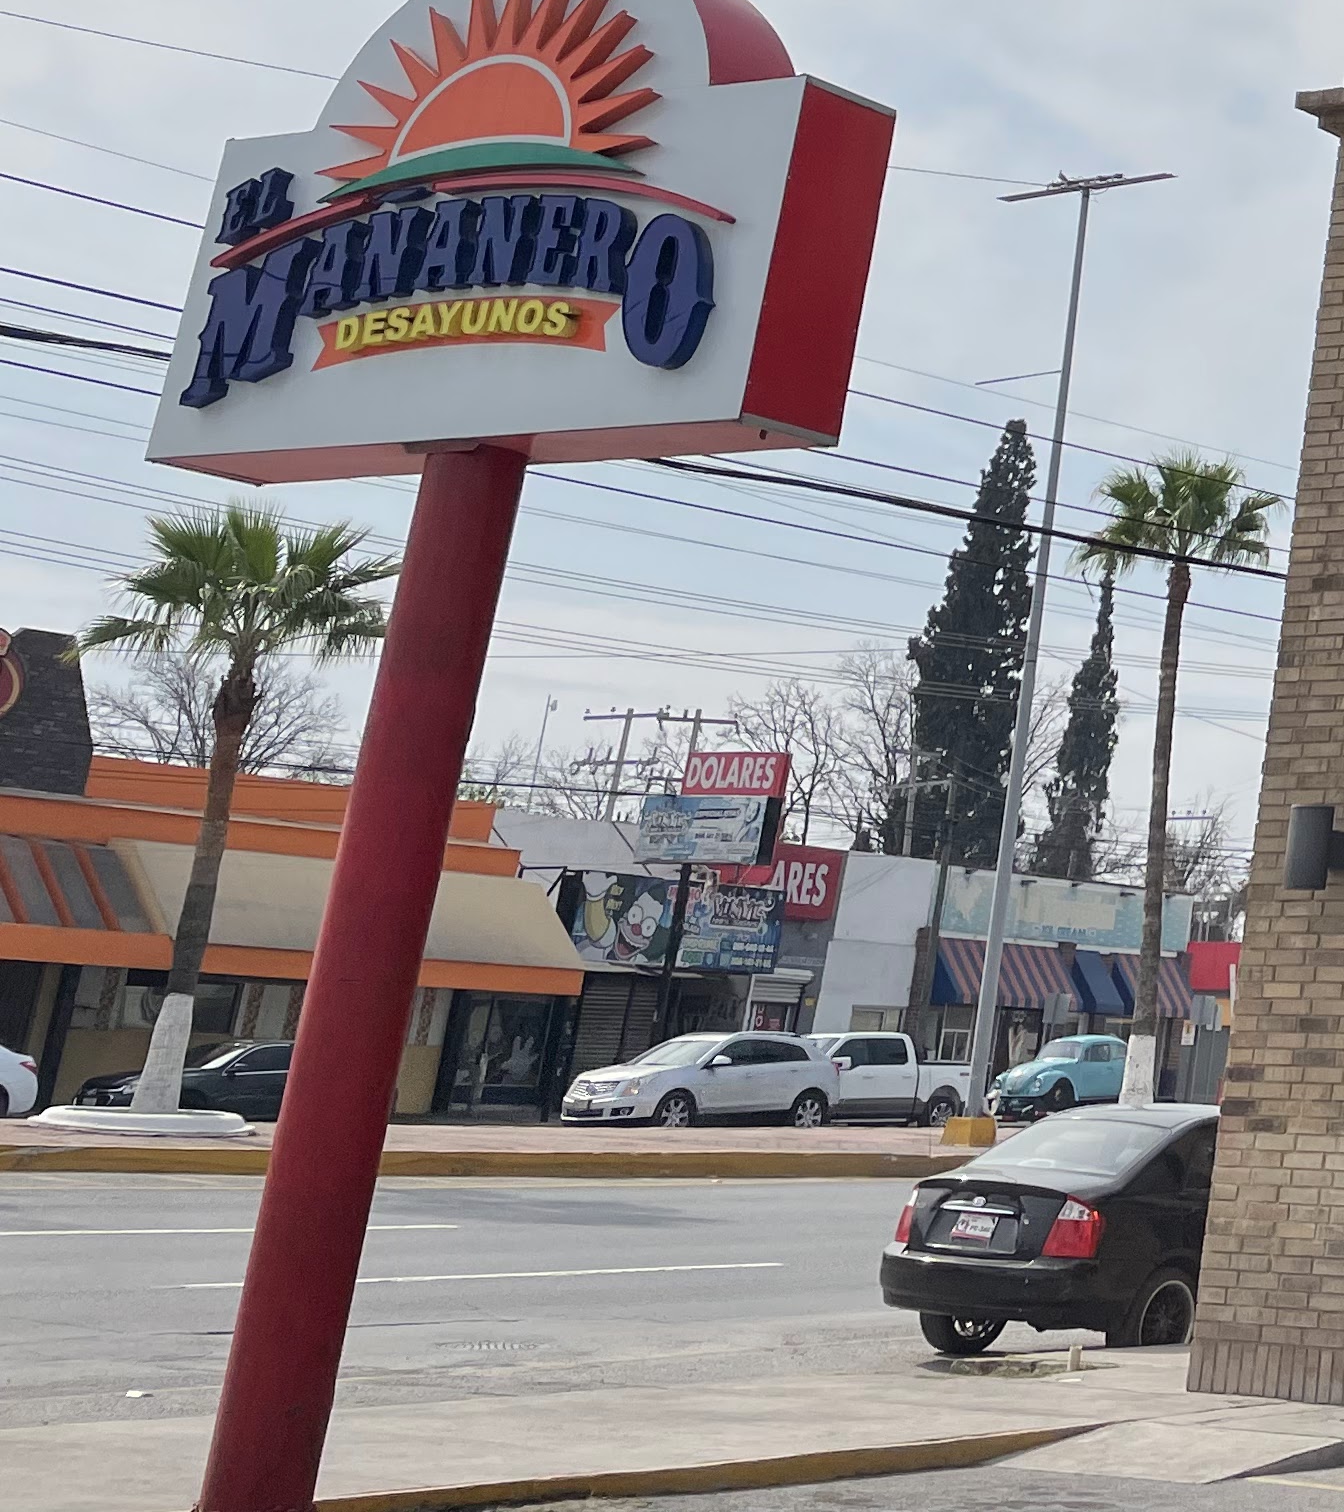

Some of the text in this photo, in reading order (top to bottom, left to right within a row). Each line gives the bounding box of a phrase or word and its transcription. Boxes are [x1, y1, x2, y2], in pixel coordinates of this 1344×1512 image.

[215, 167, 294, 245] EL
[335, 299, 578, 353] DESAYUNOS
[685, 756, 777, 789] DOLARES
[770, 859, 829, 907] ARES
